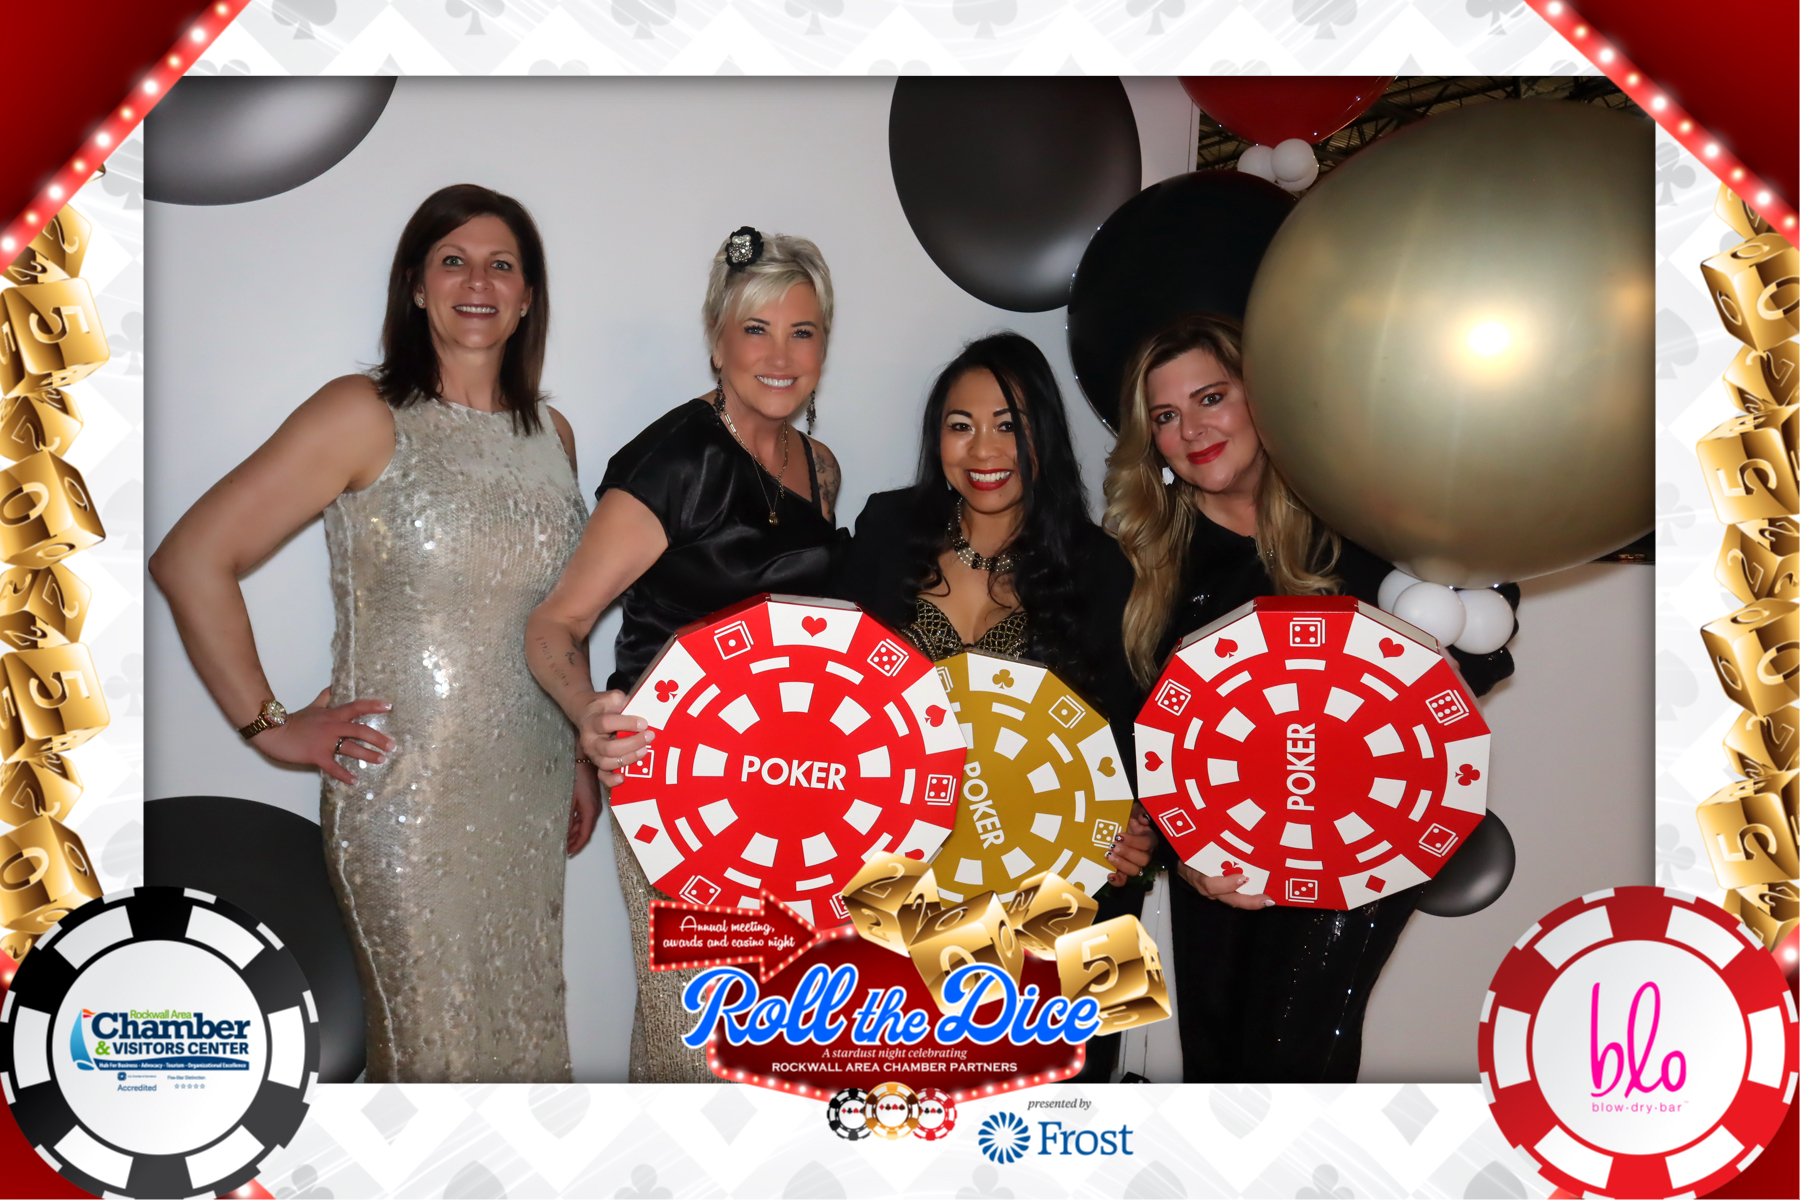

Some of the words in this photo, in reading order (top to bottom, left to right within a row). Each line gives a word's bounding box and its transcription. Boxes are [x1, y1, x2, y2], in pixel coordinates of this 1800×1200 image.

[741, 755, 847, 791] POKER
[963, 761, 1005, 850] POKER
[1286, 723, 1316, 811] POKER
